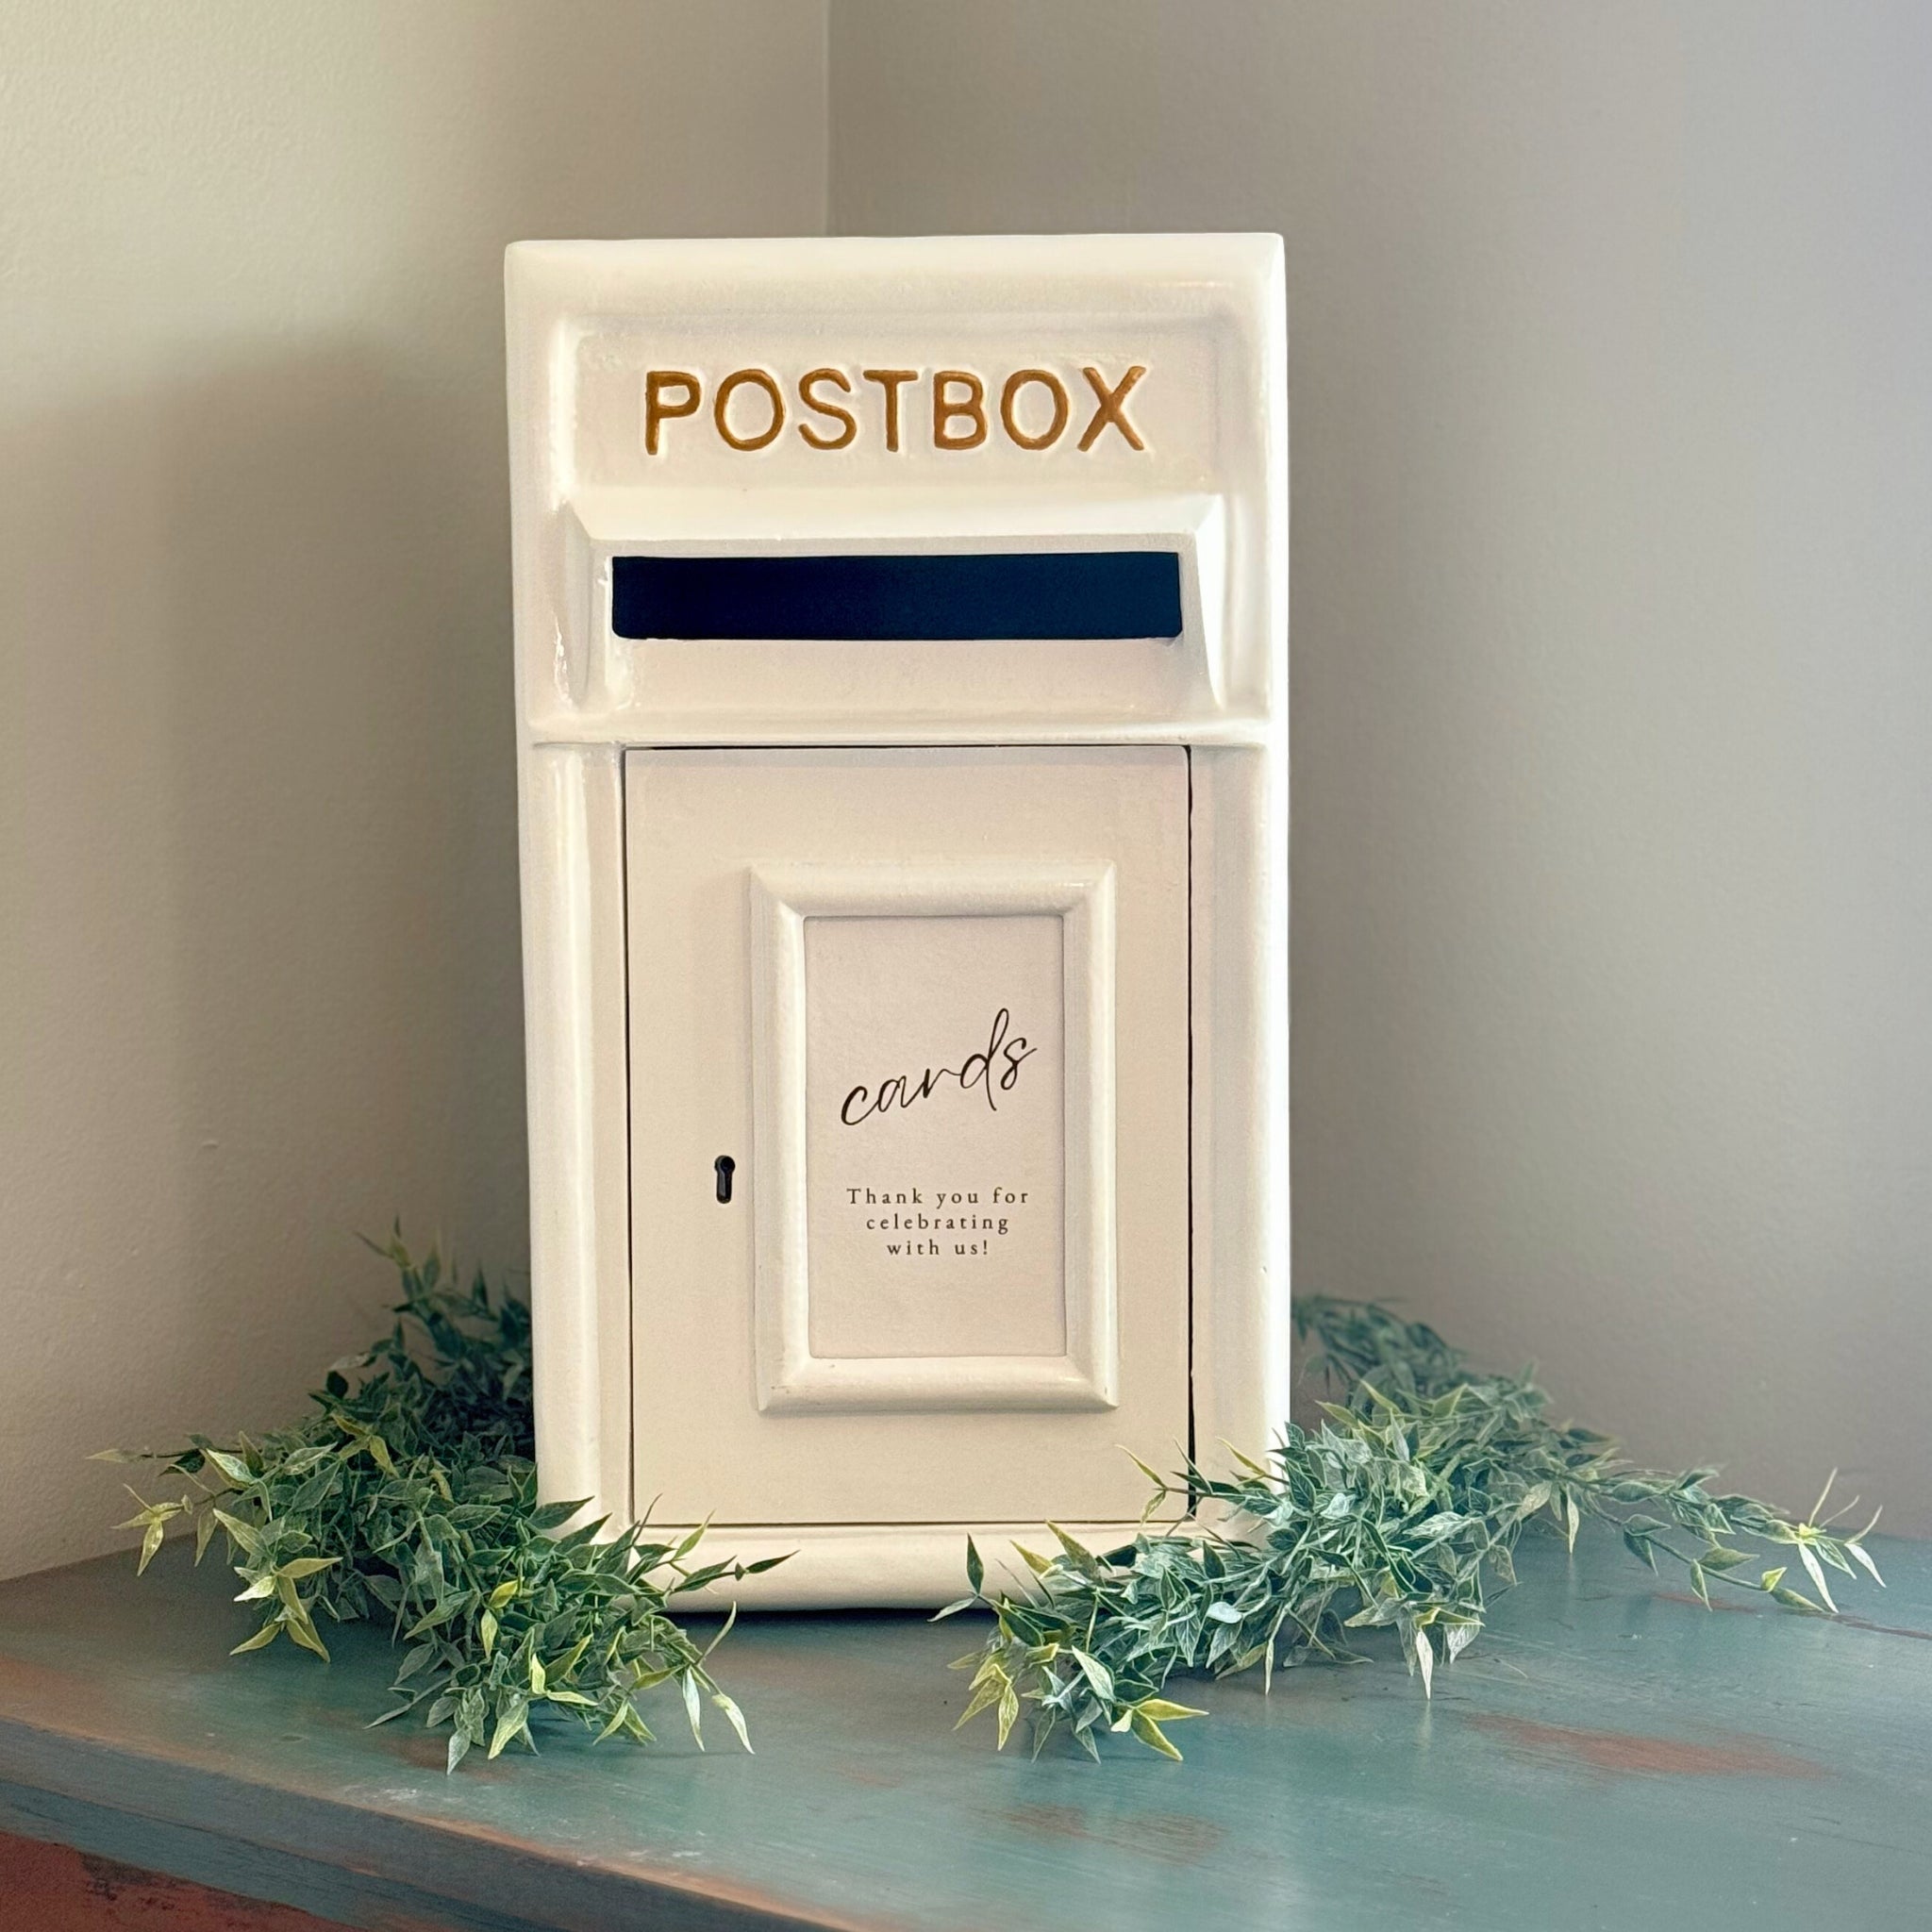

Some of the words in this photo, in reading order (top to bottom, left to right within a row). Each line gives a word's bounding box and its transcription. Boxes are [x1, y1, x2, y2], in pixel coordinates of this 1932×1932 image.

[644, 365, 1147, 456] POSTBOX
[841, 1007, 1038, 1125] cards
[845, 1187, 924, 1205] Thank
[936, 1192, 979, 1210] you
[992, 1186, 1029, 1205] for
[866, 1212, 1009, 1236] celebrating
[886, 1238, 940, 1256] with
[954, 1239, 988, 1256] us!
